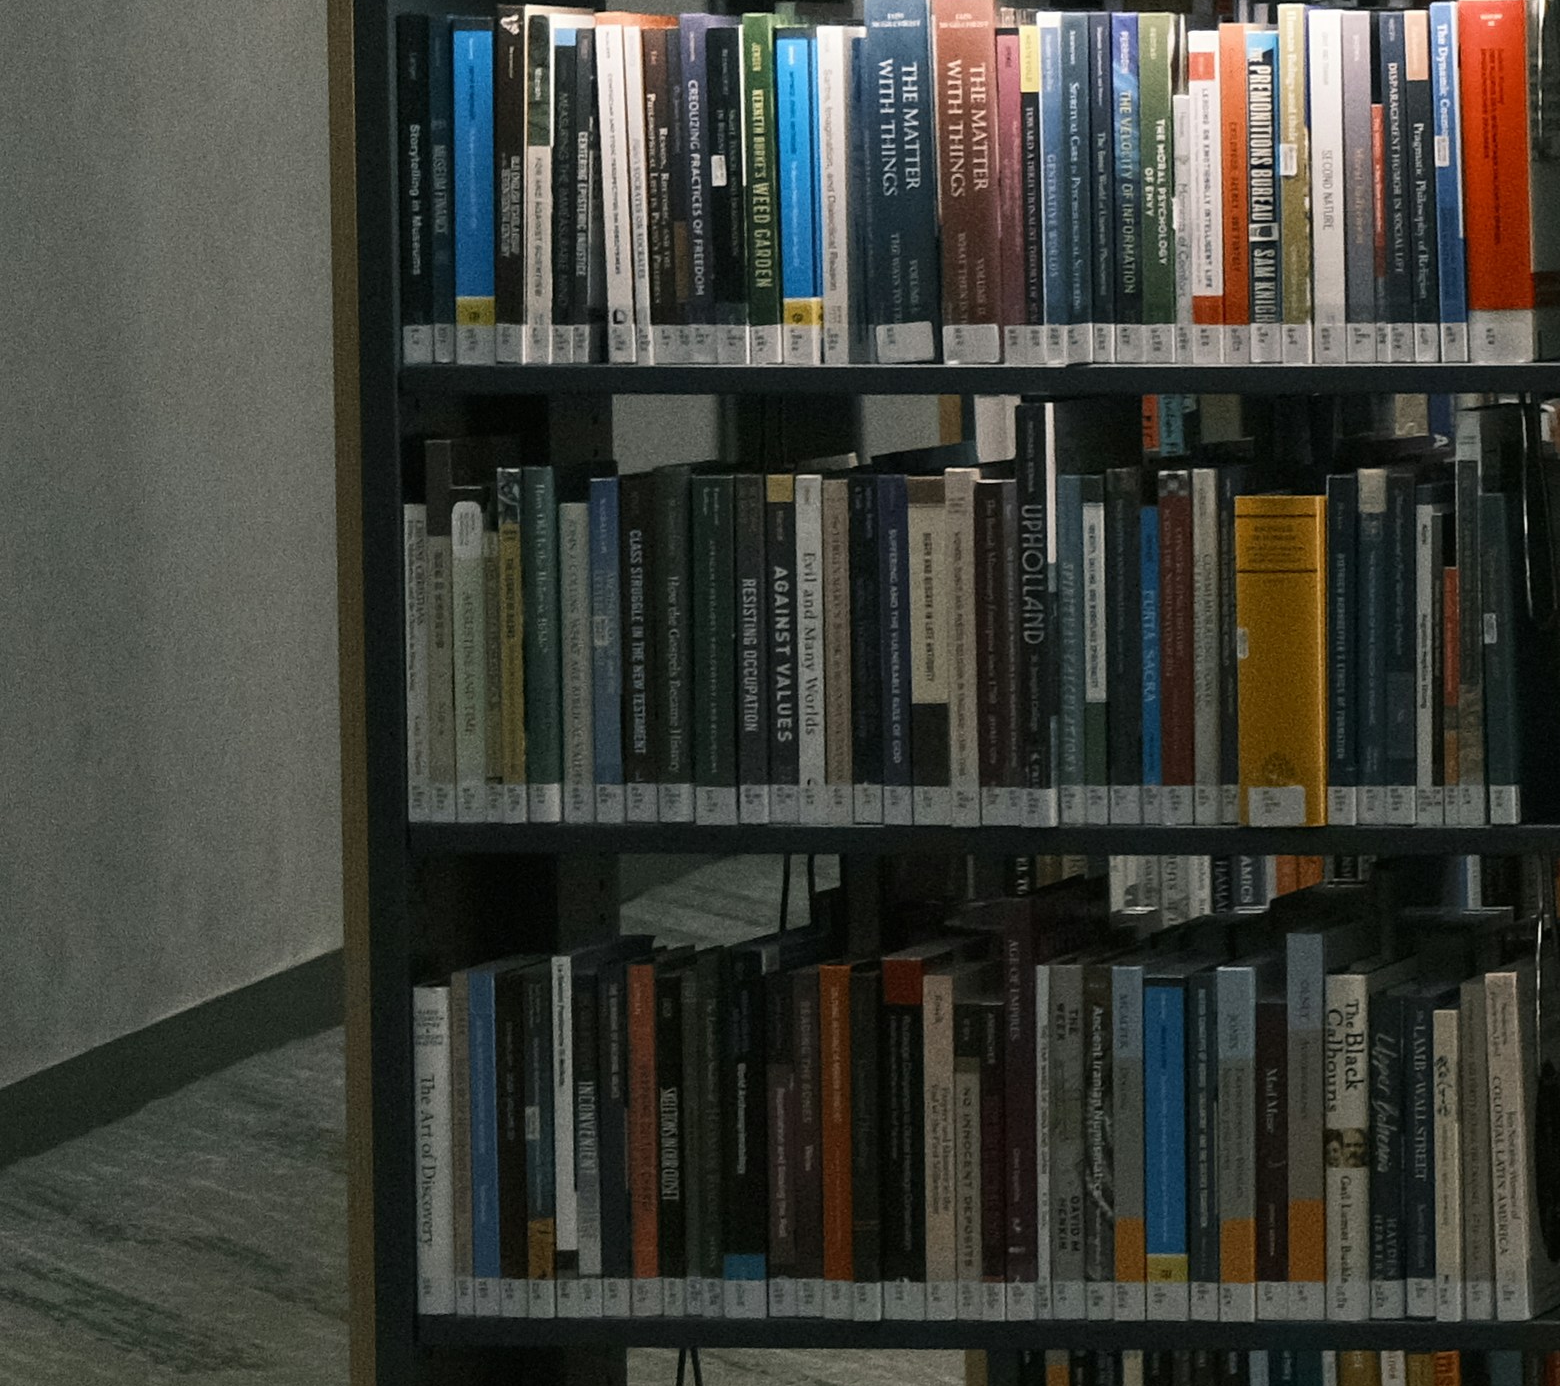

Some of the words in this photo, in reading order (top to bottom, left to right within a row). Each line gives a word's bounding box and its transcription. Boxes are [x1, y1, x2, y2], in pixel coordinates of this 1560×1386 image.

[878, 59, 895, 113] WITH
[901, 62, 918, 101] THE
[947, 59, 964, 113] WITH
[969, 62, 986, 101] THE
[1120, 91, 1132, 113] THE
[687, 79, 700, 150] CREOLIZING
[1249, 65, 1271, 165] PREMONITIONS
[409, 124, 422, 196] Storytelling
[880, 120, 898, 196] THINGS
[902, 108, 920, 189] MATTER
[949, 120, 966, 197] THINGS
[970, 107, 988, 190] MATTER
[1120, 117, 1133, 179] VELOCITY
[412, 200, 422, 212] in
[689, 153, 702, 216] PRACTICES
[752, 182, 770, 223] WEED
[1122, 184, 1134, 199] OF
[1251, 169, 1272, 221] BUREAU
[411, 216, 423, 275] Museums
[692, 219, 703, 235] OF
[1122, 203, 1135, 294] INFORMATION
[693, 238, 705, 296] FREEDOM
[754, 229, 772, 287] GARDEN
[1254, 248, 1274, 278] SAM
[1255, 282, 1277, 324] KNIGH
[802, 552, 815, 584] Evil
[1021, 504, 1044, 645] UPHOLLAND
[741, 578, 757, 646] RESISTING
[772, 565, 790, 654] AGAINST
[803, 589, 815, 619] and
[801, 626, 817, 672] Many
[742, 650, 758, 732] OCCUPATION
[775, 664, 792, 743] VALUES
[804, 676, 819, 736] Worlds
[1345, 999, 1359, 1028] The
[1325, 1008, 1342, 1113] Calhouns
[1344, 1033, 1363, 1090] Black
